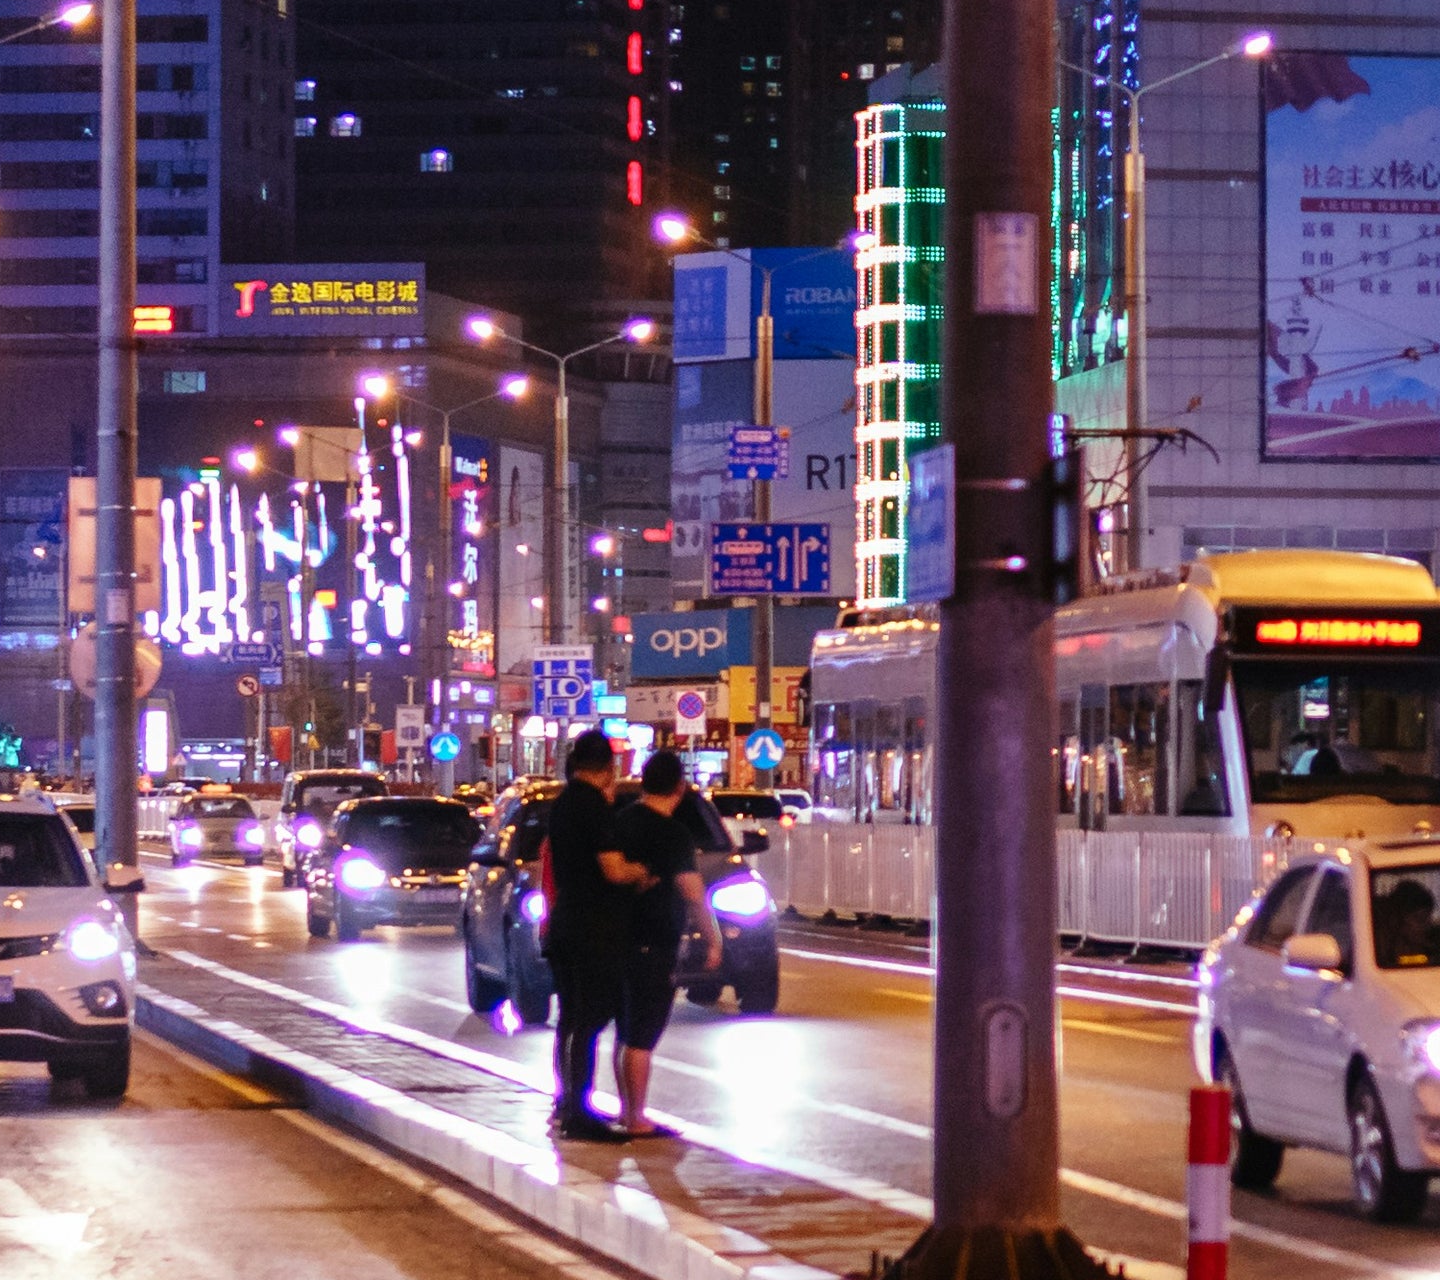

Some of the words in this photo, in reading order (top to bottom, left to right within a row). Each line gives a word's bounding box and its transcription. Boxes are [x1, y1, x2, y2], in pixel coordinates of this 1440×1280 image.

[270, 281, 418, 303] 金逸国际电影城
[807, 454, 856, 490] R1
[650, 627, 727, 657] opp
